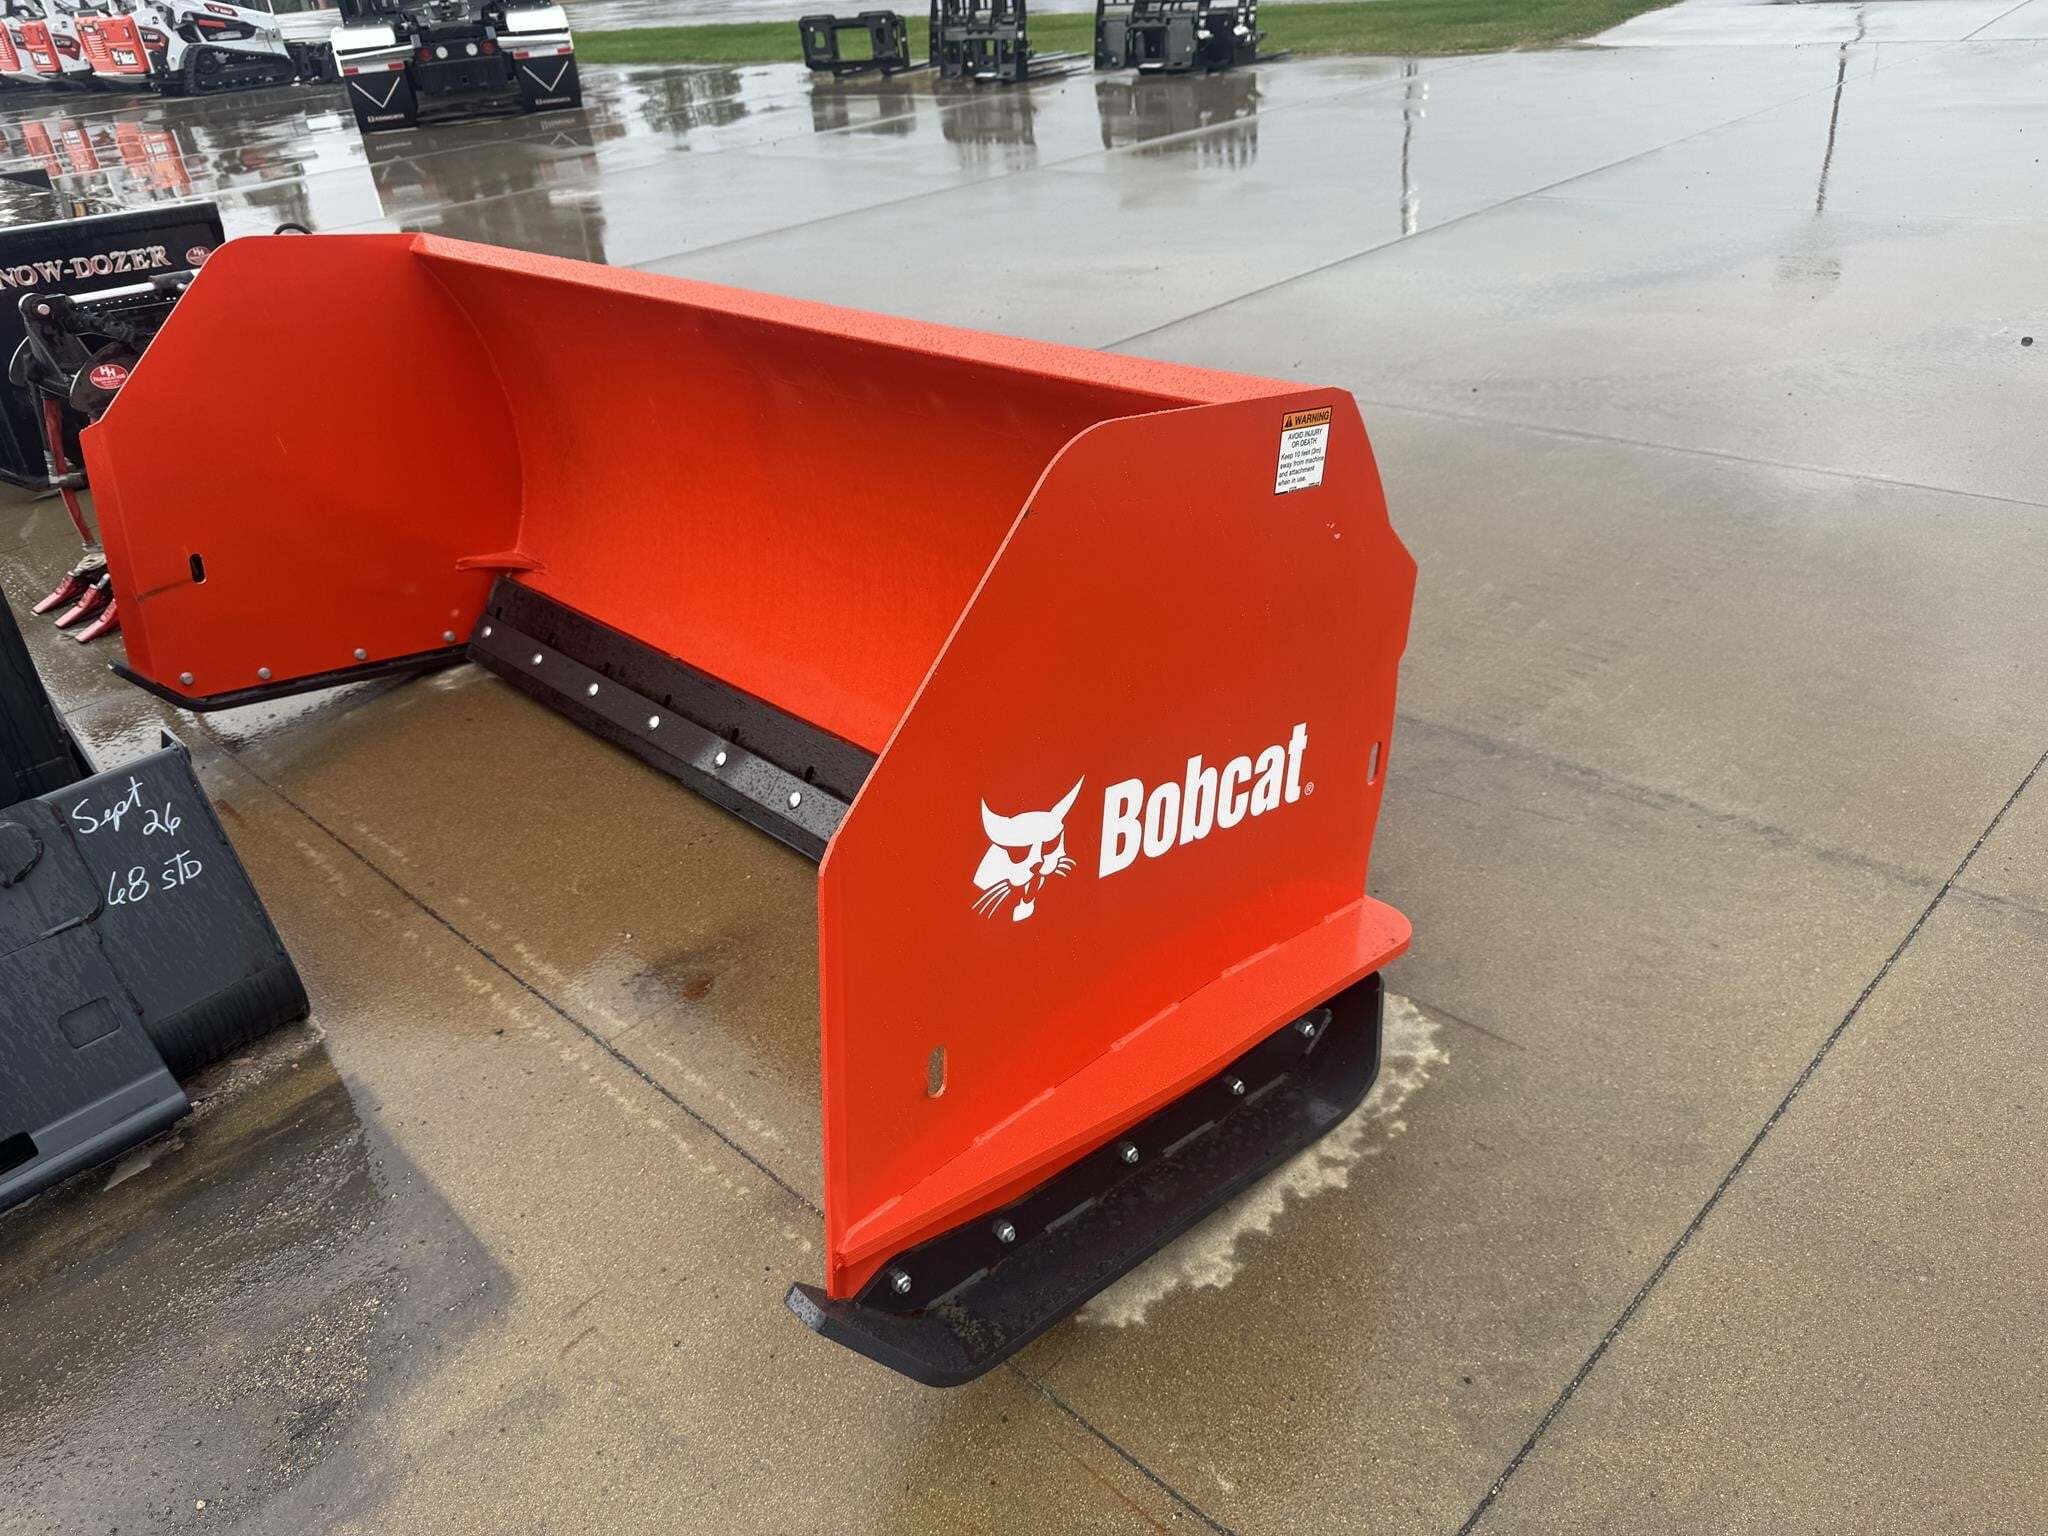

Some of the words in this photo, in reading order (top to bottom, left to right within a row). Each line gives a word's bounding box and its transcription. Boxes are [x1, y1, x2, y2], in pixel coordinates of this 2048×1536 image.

[1295, 411, 1329, 425] WARNING
[1288, 432, 1303, 440] AVOID
[1305, 428, 1322, 437] INJURY
[1300, 438, 1317, 447] DEATH
[1281, 453, 1293, 461] Keep
[1279, 470, 1289, 478] and
[1289, 466, 1315, 476] attachment
[1280, 462, 1292, 470] away
[71, 776, 144, 834] Sept
[142, 802, 182, 836] 26
[107, 866, 150, 906] 68
